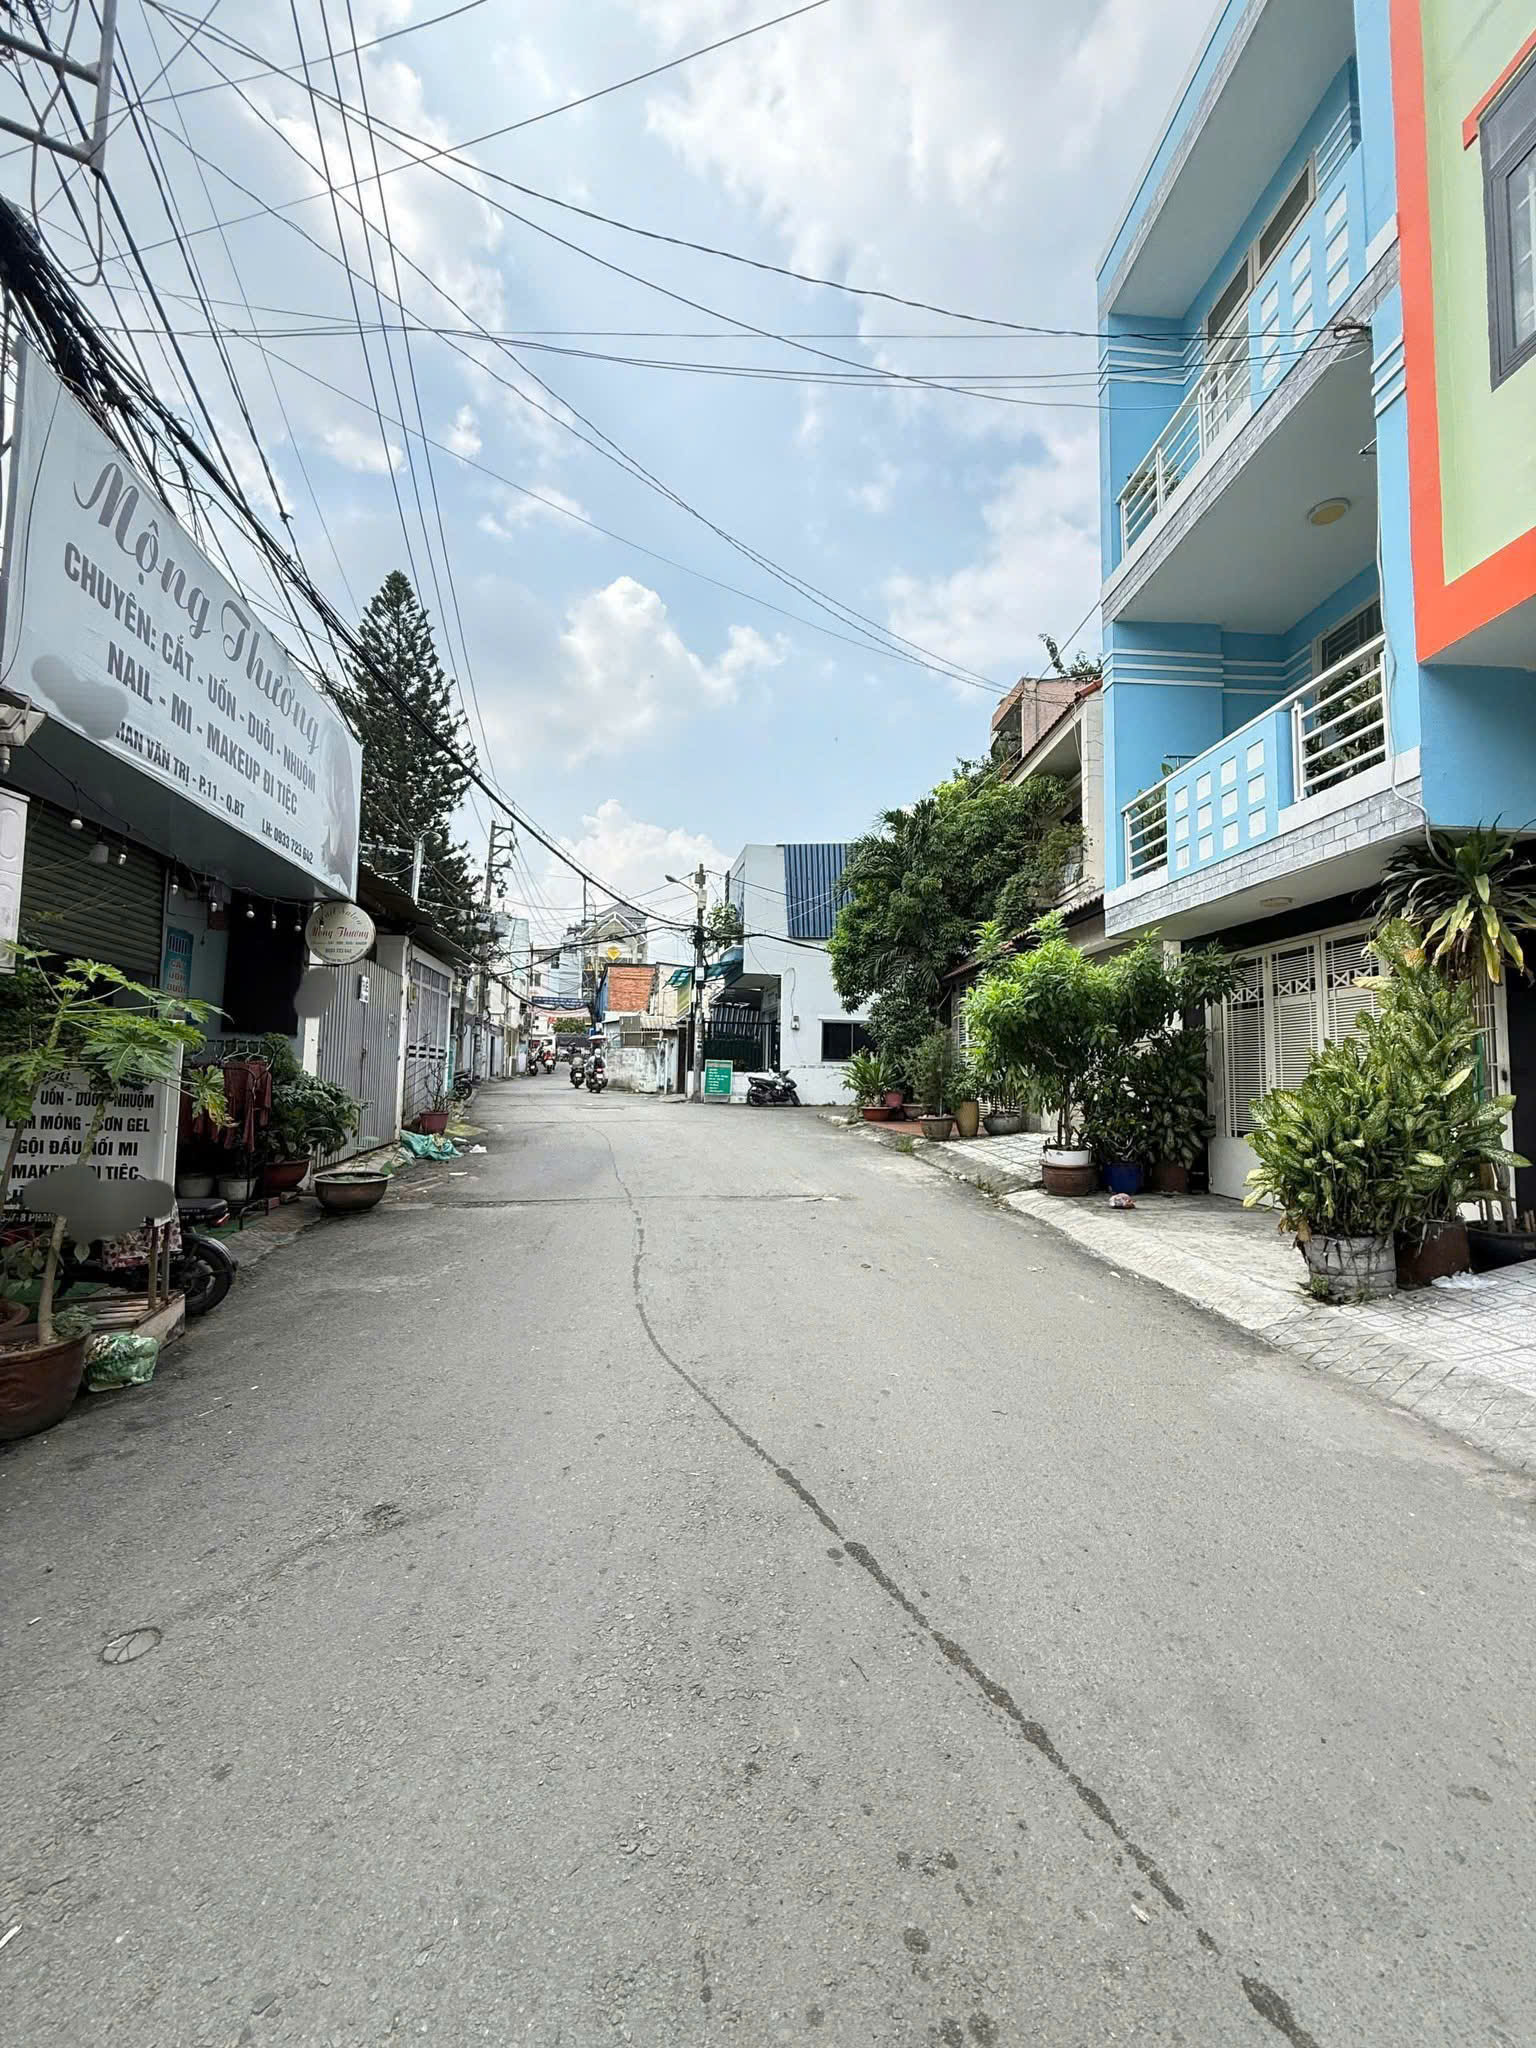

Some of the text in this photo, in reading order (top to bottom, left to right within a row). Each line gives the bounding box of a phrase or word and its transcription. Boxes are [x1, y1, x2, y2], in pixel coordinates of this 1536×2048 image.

[64, 542, 157, 652] CHUYÊN:
[162, 632, 194, 682] CẮT
[208, 673, 236, 722] UỐN
[73, 463, 319, 755] Mộng Thường
[107, 640, 153, 705] NAIL
[171, 692, 192, 734] MI
[207, 721, 260, 784] MAKEUP
[263, 768, 274, 798] ĐI
[277, 780, 297, 815] TIỆC
[146, 739, 171, 771] VĂN
[173, 757, 190, 786] TRỊ
[199, 774, 217, 801] P.11
[226, 794, 246, 819] Q.BT
[40, 1113, 81, 1131] MÓNG
[127, 1118, 150, 1132] GEL
[41, 1086, 64, 1105] UỐN
[118, 1142, 138, 1156] MI
